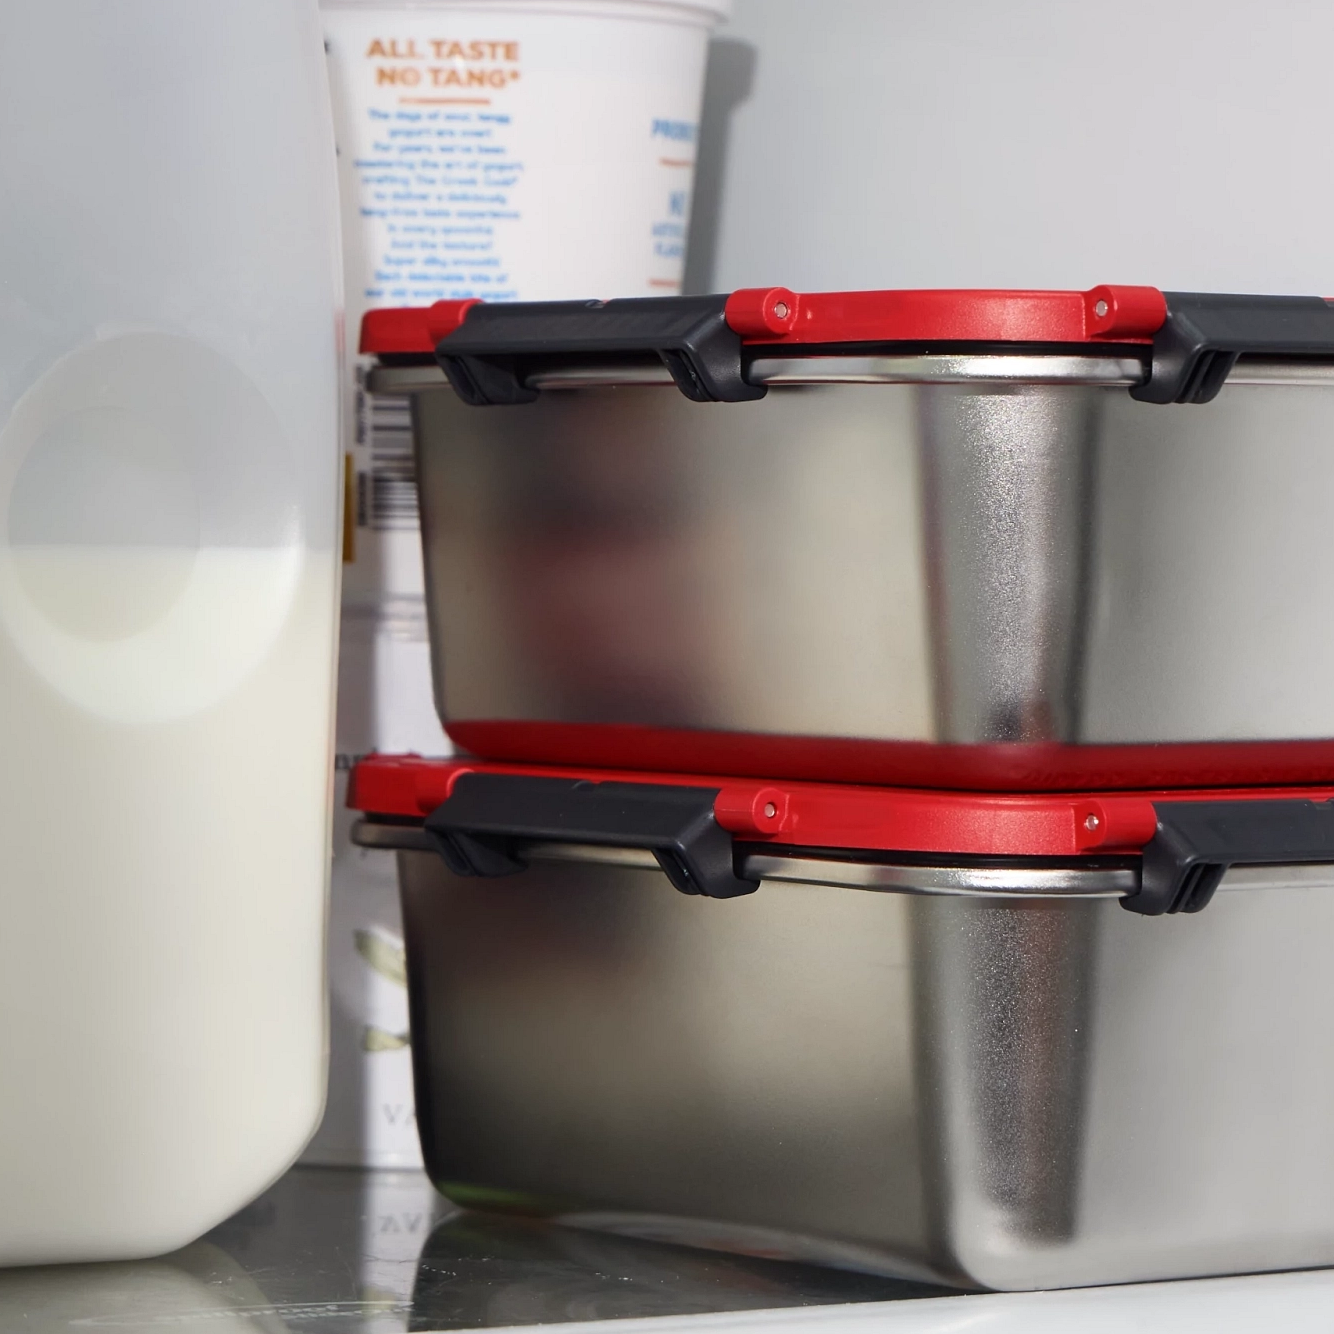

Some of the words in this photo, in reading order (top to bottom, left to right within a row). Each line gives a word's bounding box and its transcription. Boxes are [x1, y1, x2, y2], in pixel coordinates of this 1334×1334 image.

[367, 39, 425, 60] ALL
[432, 42, 520, 62] TASTE
[377, 68, 421, 87] NO
